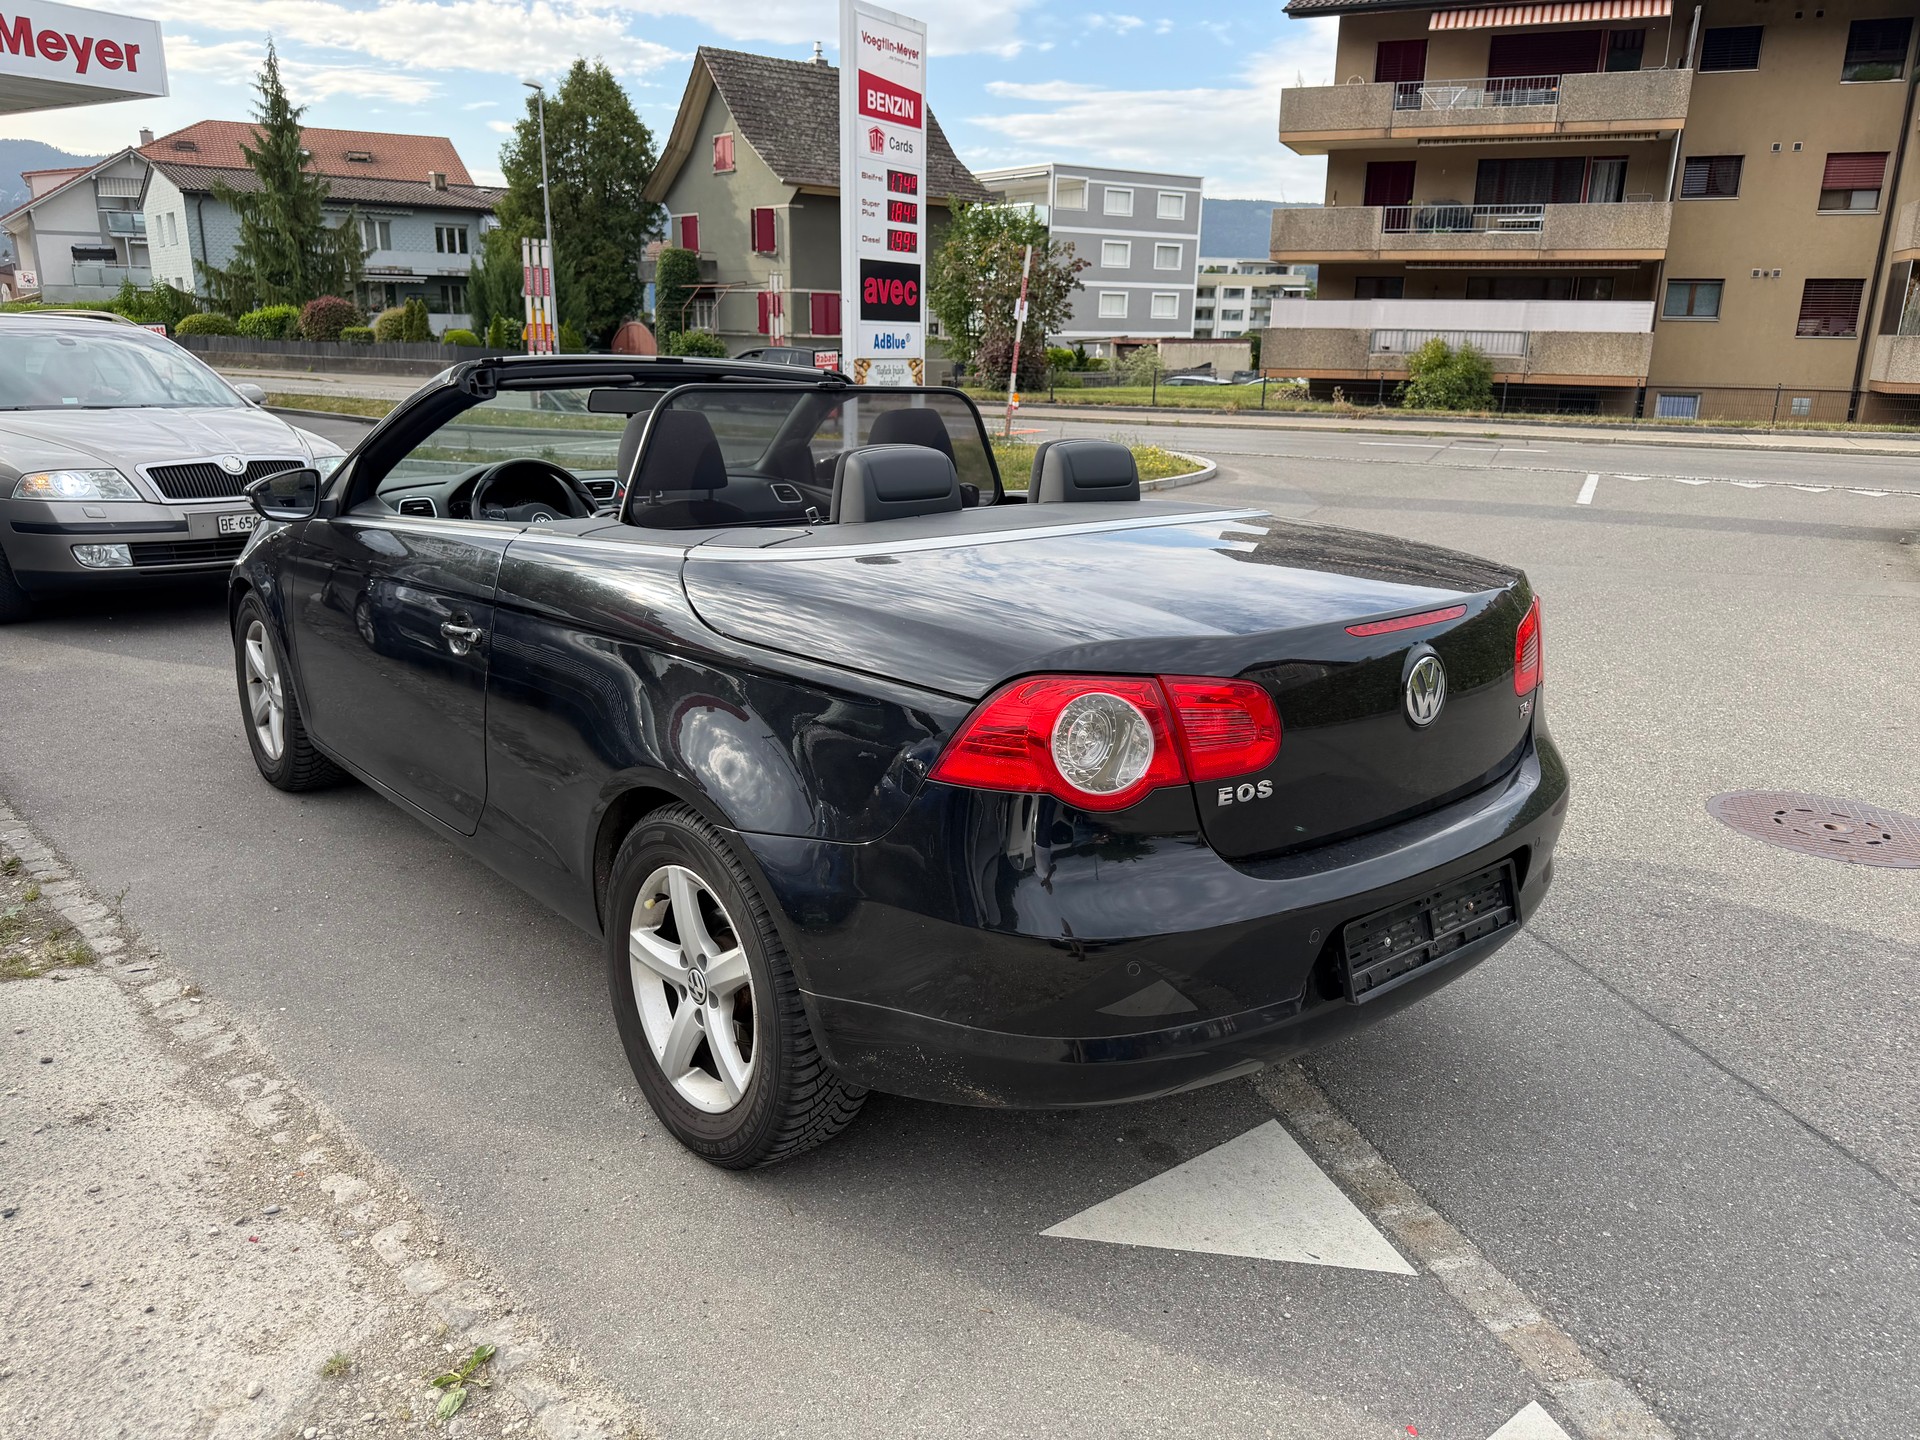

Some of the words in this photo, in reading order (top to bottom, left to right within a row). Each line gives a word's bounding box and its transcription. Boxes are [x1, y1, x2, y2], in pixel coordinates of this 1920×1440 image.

[861, 30, 920, 61] Voegtlin-Meyer
[866, 89, 915, 120] BENZIN
[889, 136, 914, 154] Cards
[861, 171, 884, 183] Bleifrei
[861, 198, 881, 210] Super
[861, 209, 876, 218] Plus
[861, 234, 881, 244] Diesel
[863, 277, 918, 307] avec
[815, 354, 838, 364] Rabatt
[1217, 779, 1274, 807] EOS
[719, 1014, 774, 1156] EUROWINTER
